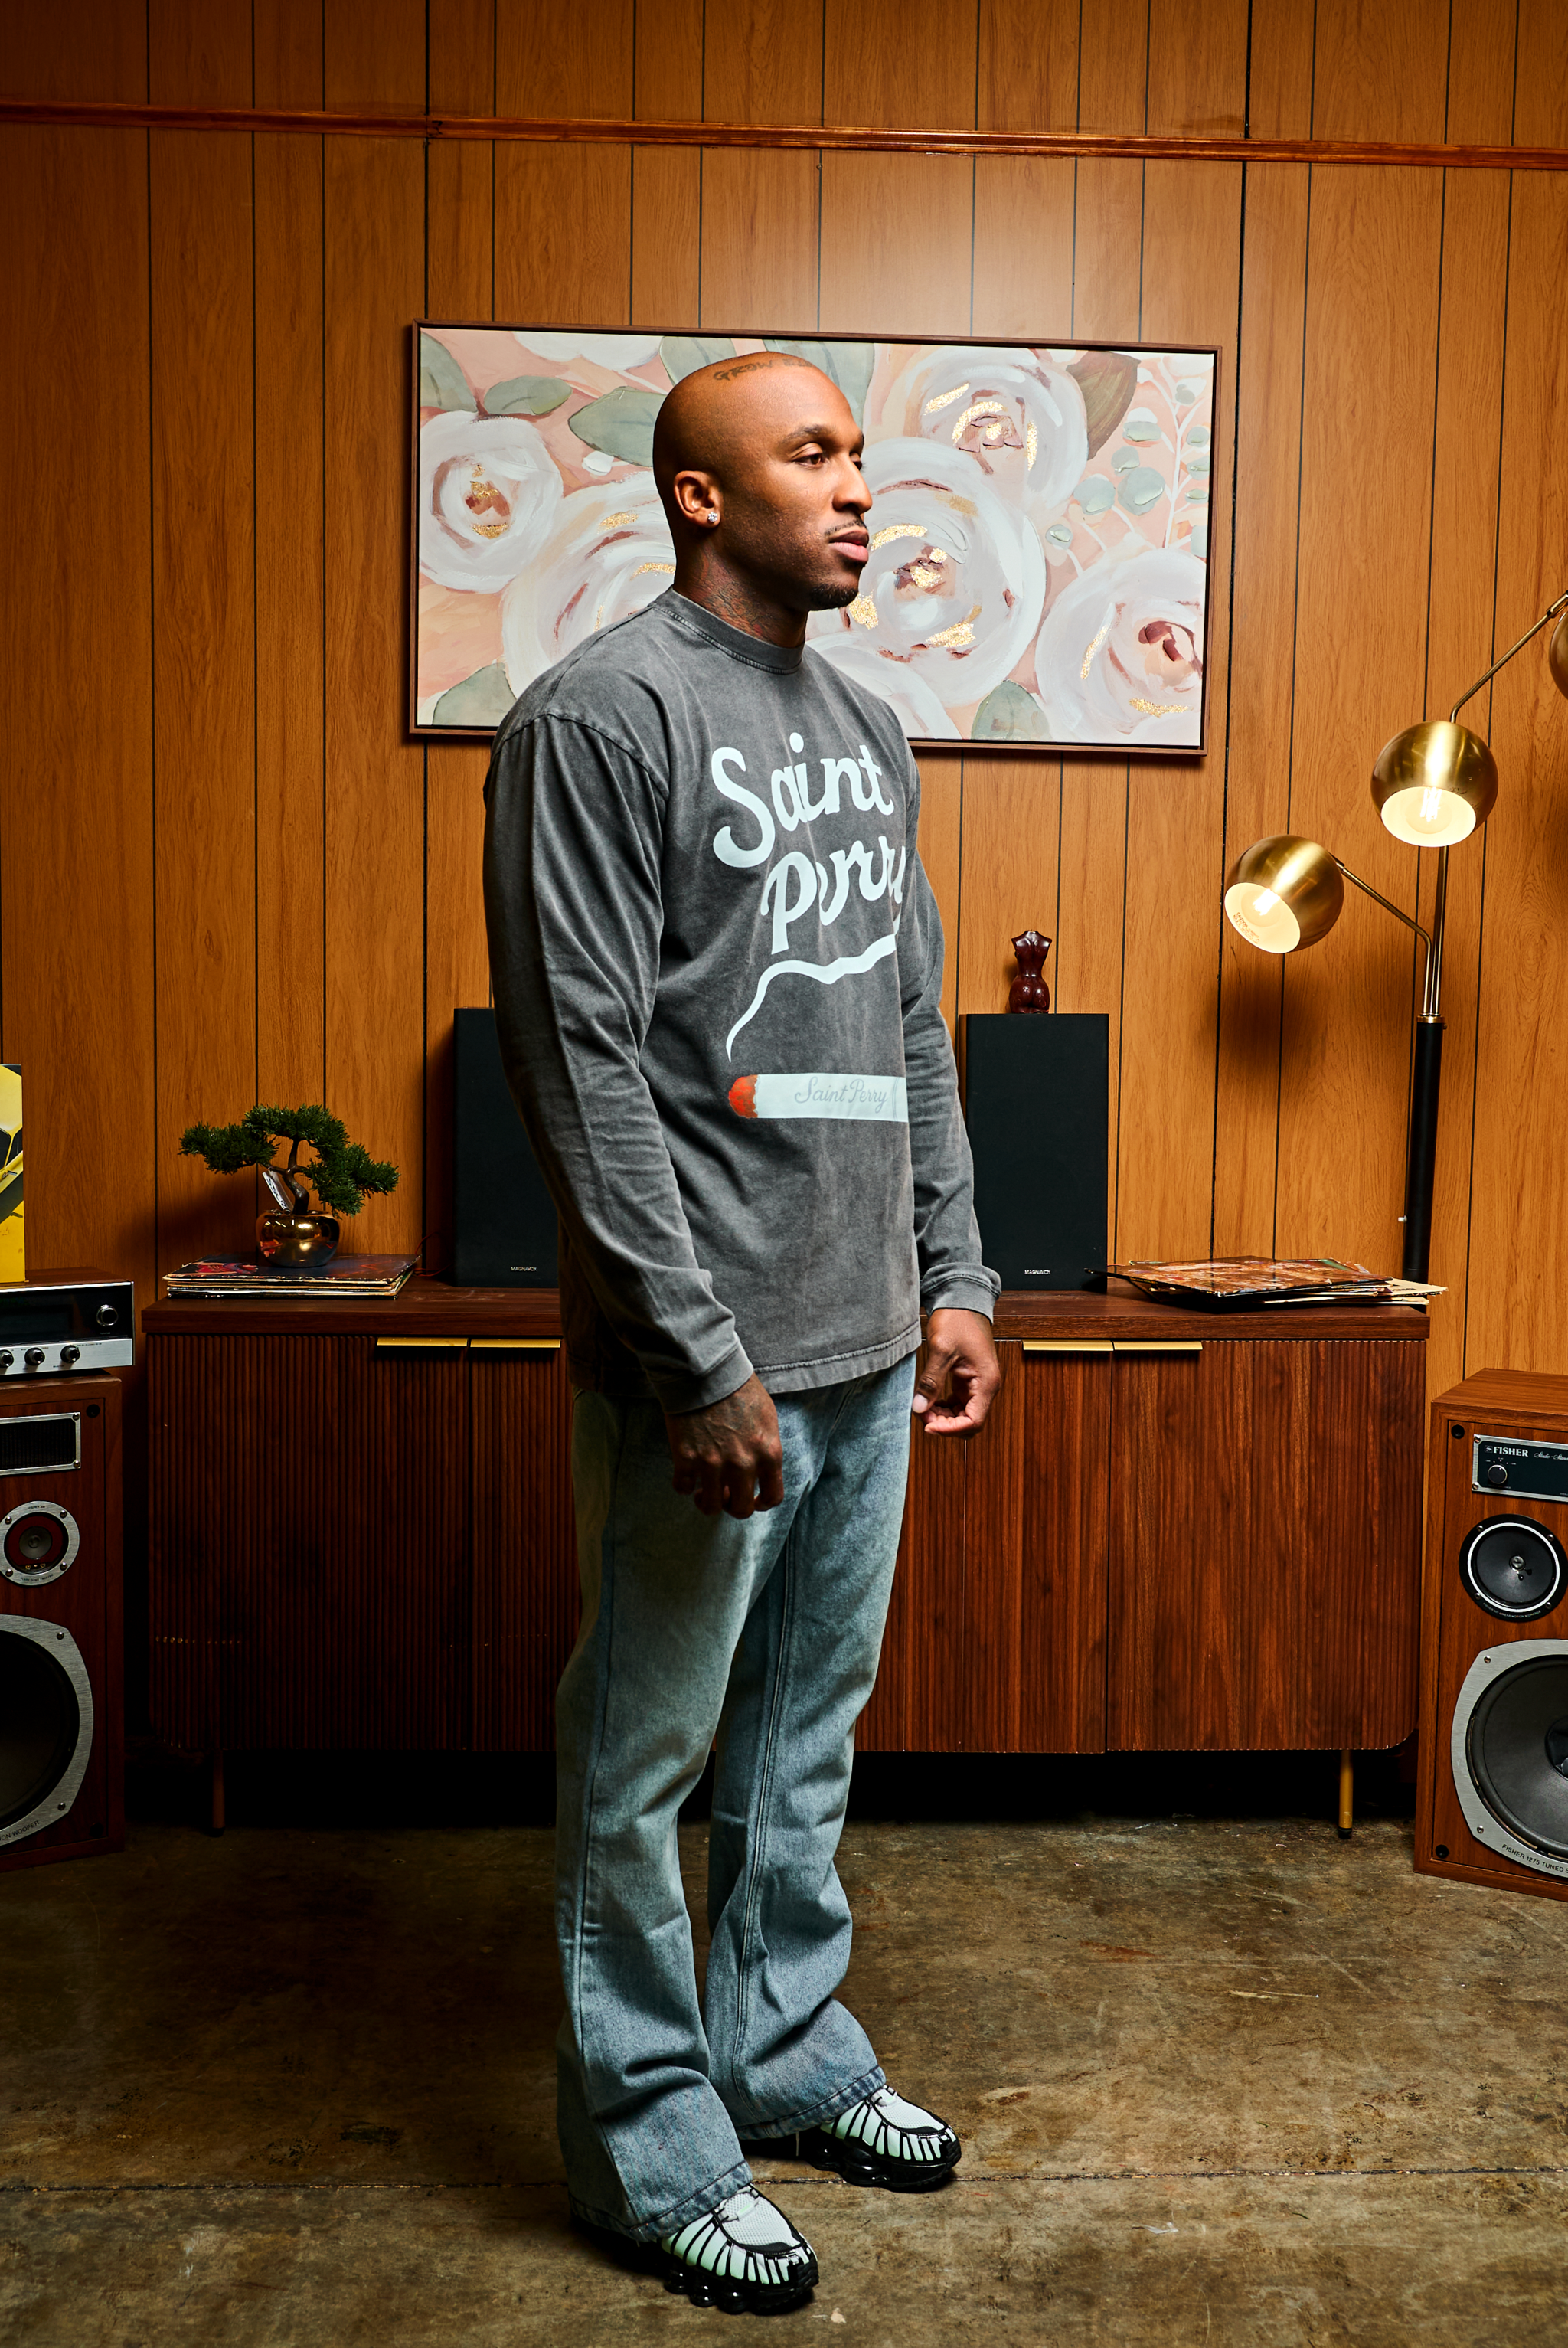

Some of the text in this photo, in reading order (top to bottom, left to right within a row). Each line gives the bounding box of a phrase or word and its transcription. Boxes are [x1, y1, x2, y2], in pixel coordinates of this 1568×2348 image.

[711, 732, 895, 868] Saint
[794, 1076, 888, 1114] Saint Perry
[1494, 1446, 1529, 1457] FISHER
[12, 1820, 40, 1836] WOOFER
[1502, 1843, 1525, 1859] FISHER
[1526, 1856, 1540, 1866] 1275
[1541, 1861, 1564, 1872] TUNED
